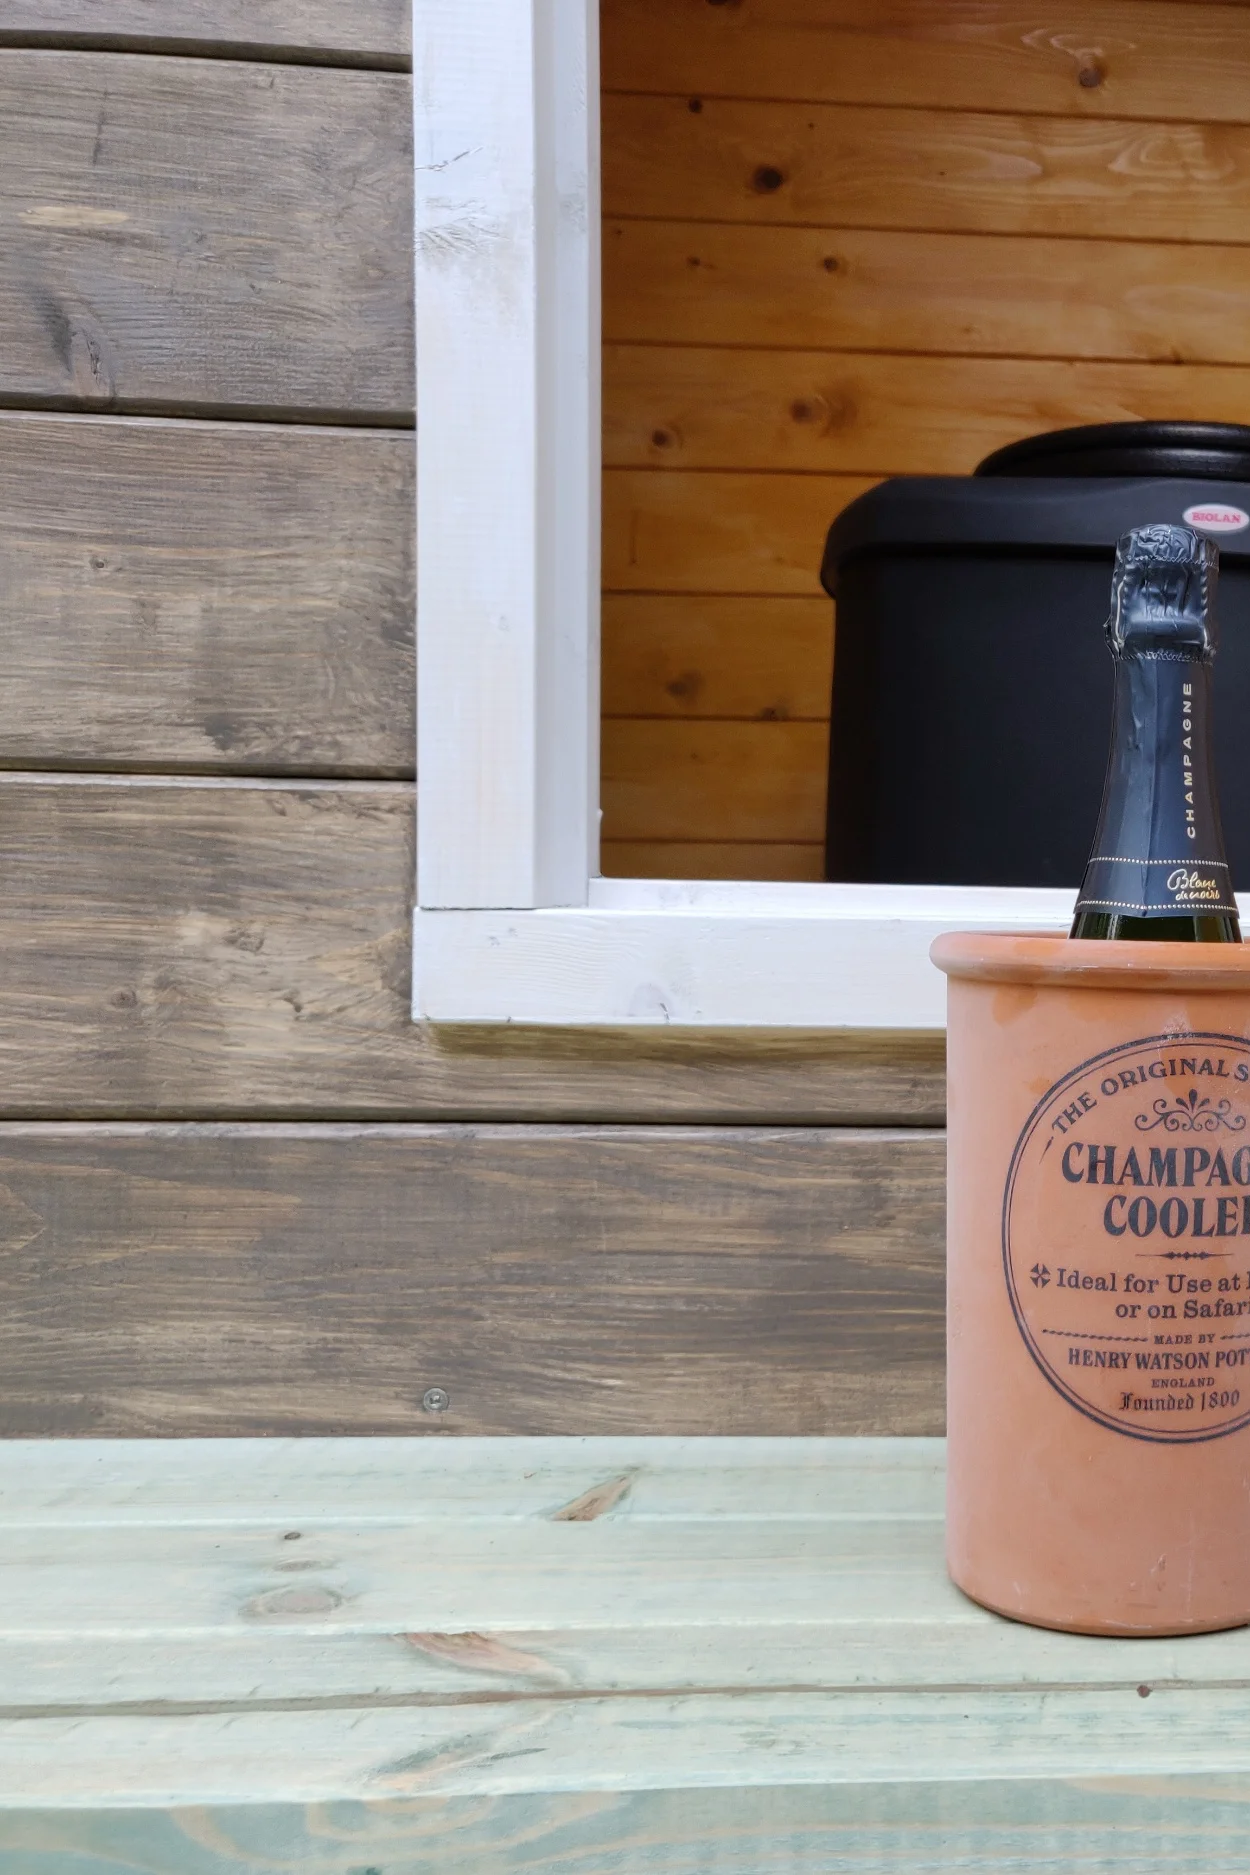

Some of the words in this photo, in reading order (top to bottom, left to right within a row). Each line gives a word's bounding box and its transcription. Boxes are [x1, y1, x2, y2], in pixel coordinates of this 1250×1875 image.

[1191, 512, 1241, 523] BIOLAN
[1183, 682, 1196, 839] CHAMPAGNE
[1051, 1092, 1098, 1134] THE
[1100, 1058, 1230, 1096] ORIGINAL
[1056, 1268, 1117, 1292] Ideal
[1124, 1274, 1159, 1293] for
[1166, 1274, 1213, 1293] Use
[1219, 1274, 1240, 1292] at
[1115, 1302, 1142, 1318] or
[1147, 1303, 1178, 1319] on
[1154, 1335, 1193, 1344] MADE
[1199, 1334, 1216, 1343] BY
[1068, 1348, 1130, 1369] HENRY
[1135, 1352, 1210, 1370] WATSON
[1151, 1377, 1215, 1388] ENGLAND
[1119, 1390, 1194, 1411] Founded
[1201, 1390, 1241, 1412] 1800
